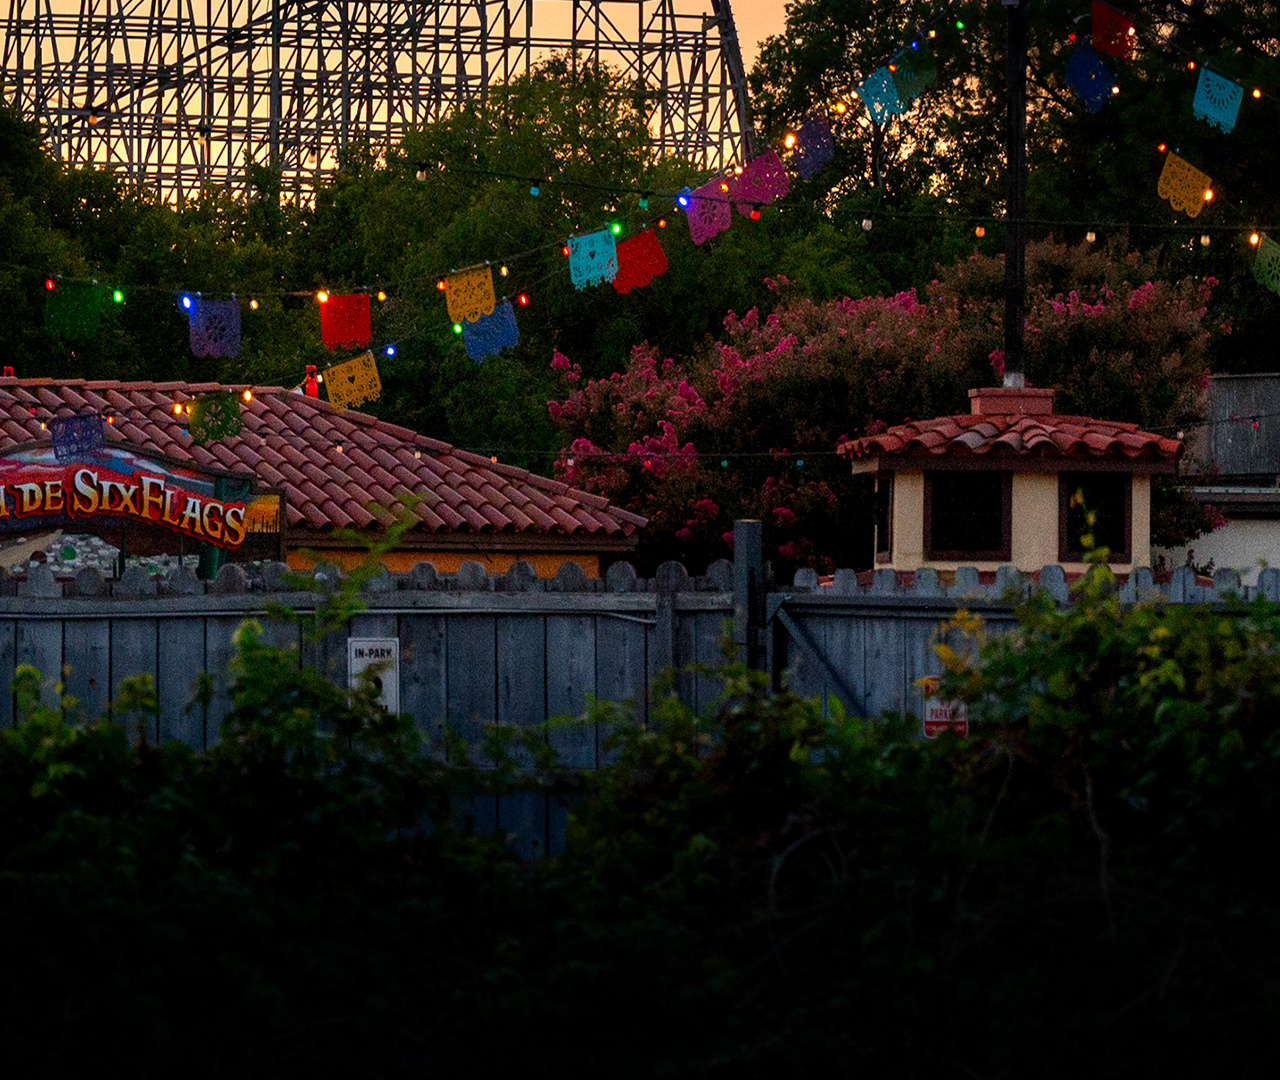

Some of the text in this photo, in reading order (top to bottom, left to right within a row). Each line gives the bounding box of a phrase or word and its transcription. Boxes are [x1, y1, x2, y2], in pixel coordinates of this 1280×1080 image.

[17, 479, 65, 512] DE
[73, 468, 140, 514] SIX
[140, 475, 247, 546] FLAGS
[354, 648, 393, 659] IN-PARK
